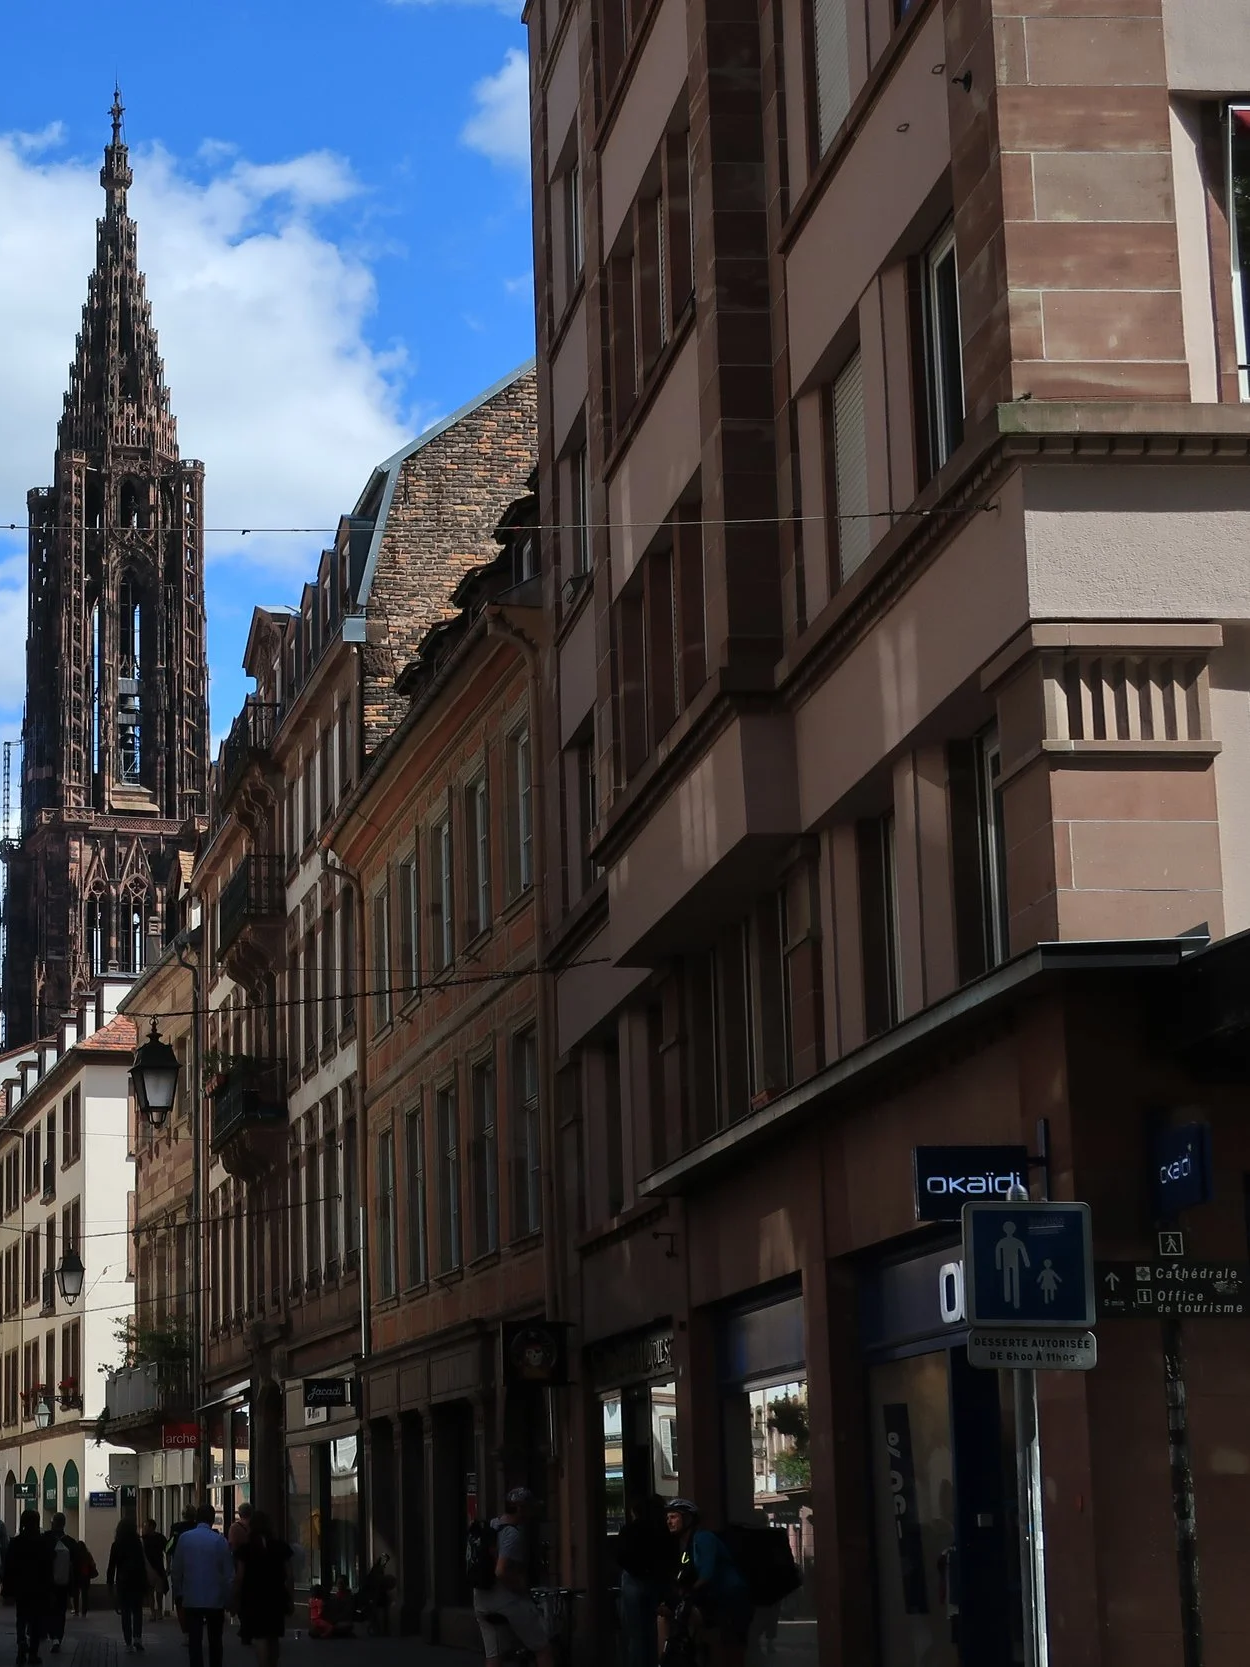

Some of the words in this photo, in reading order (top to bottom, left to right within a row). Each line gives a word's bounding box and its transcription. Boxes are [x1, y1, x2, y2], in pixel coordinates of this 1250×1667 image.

[1155, 1266, 1238, 1280] Cathédrale
[1157, 1290, 1205, 1302] Office
[1157, 1304, 1171, 1313] de
[1178, 1303, 1244, 1313] tourisme
[974, 1337, 1029, 1348] DESSERTE
[1031, 1338, 1091, 1349] AUTORISÉE
[990, 1352, 1003, 1361] DE
[1036, 1350, 1043, 1362] À
[165, 1432, 198, 1444] arche
